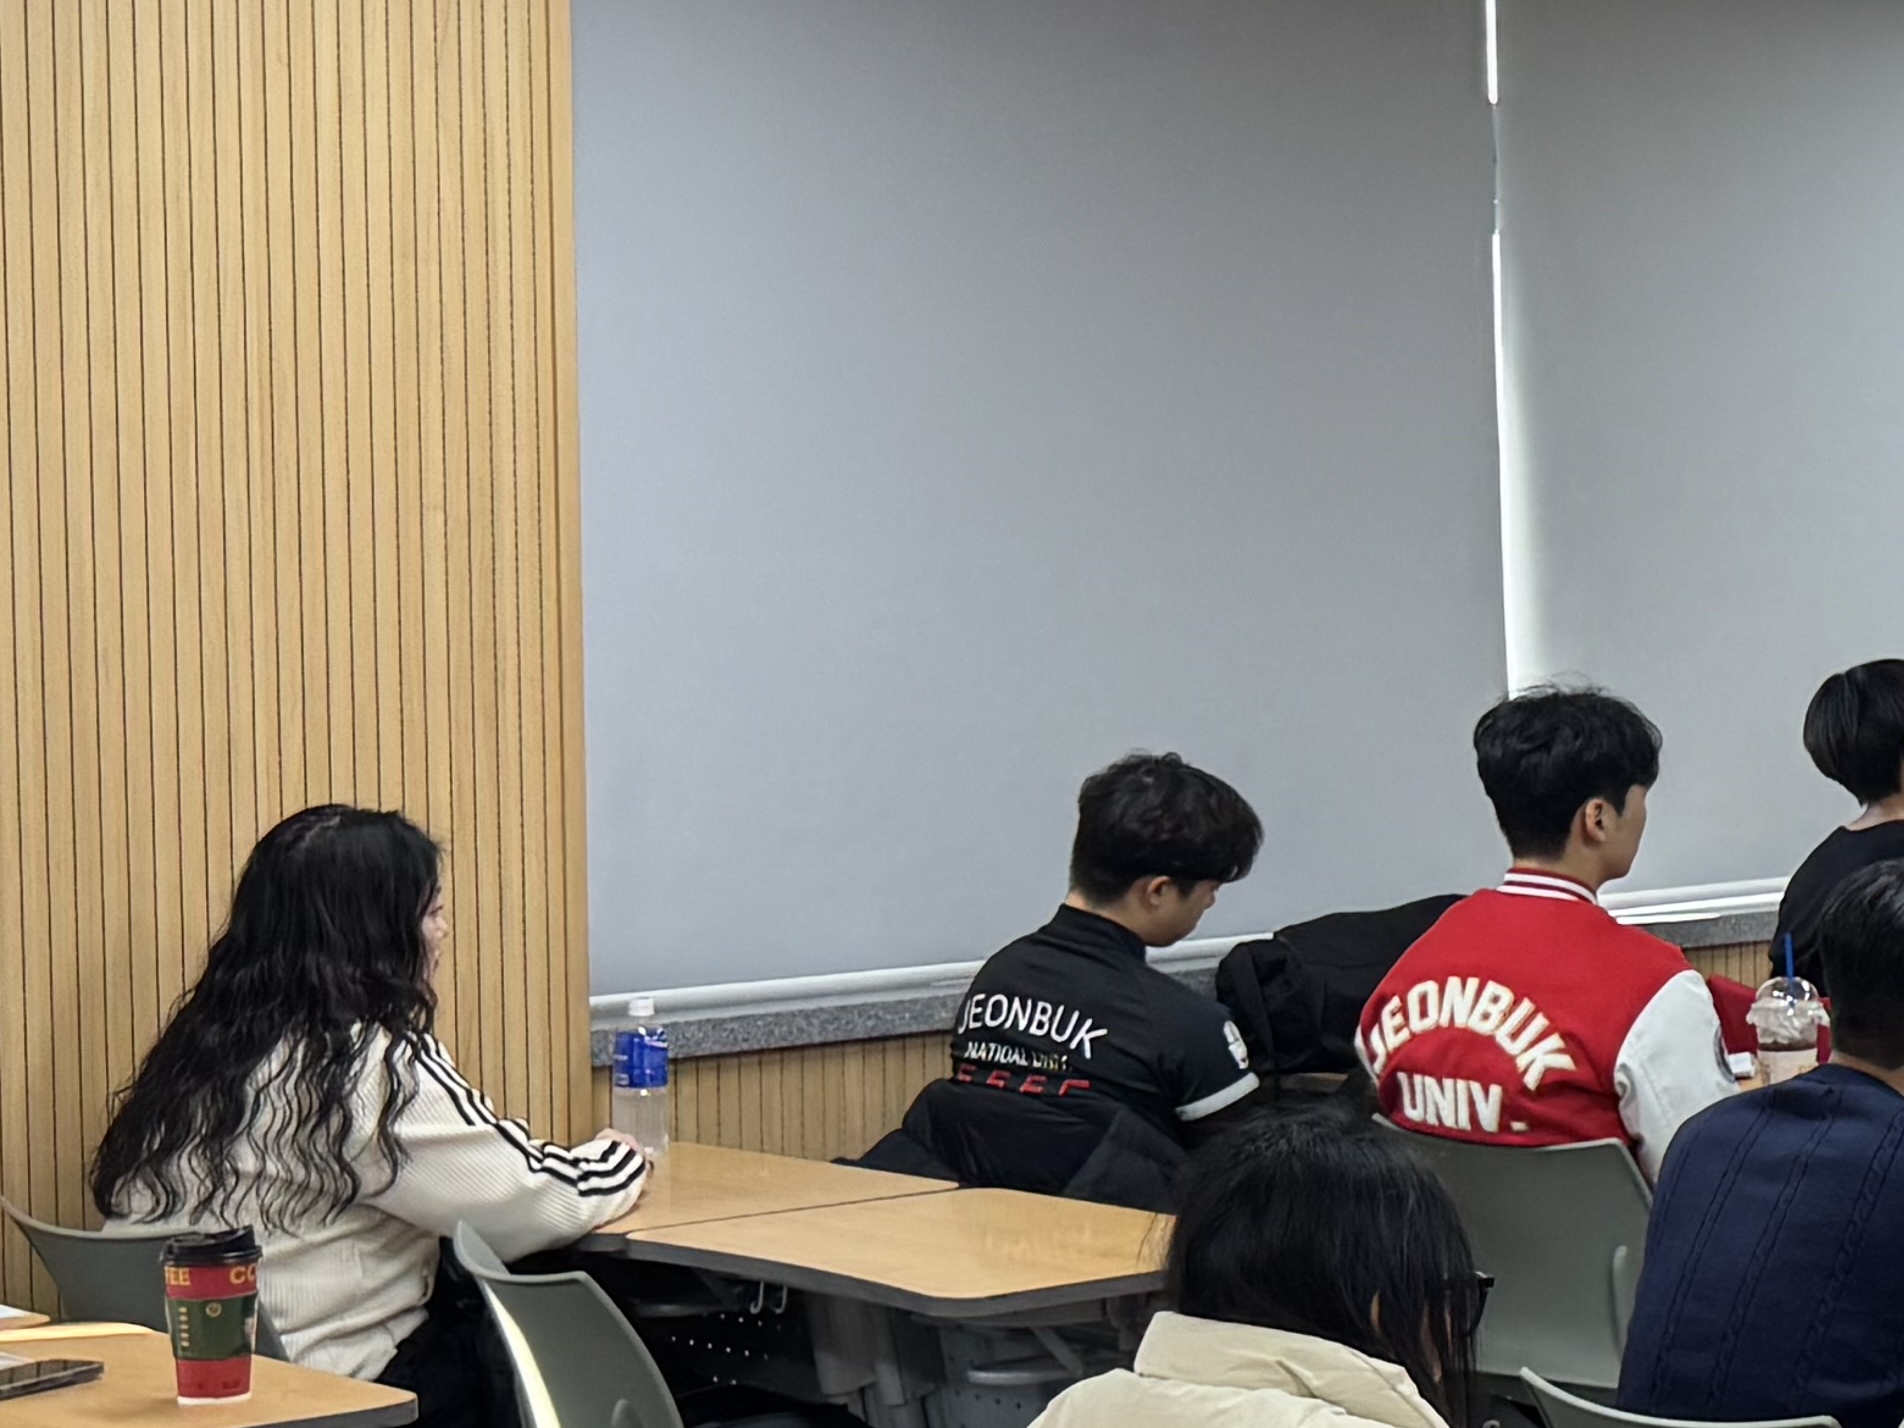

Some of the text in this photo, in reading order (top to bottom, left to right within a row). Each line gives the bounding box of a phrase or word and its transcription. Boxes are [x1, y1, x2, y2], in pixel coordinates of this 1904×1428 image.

[958, 993, 1108, 1060] JEONBUK
[1369, 976, 1576, 1091] JEONBUK
[1397, 1072, 1529, 1133] UNIV.
